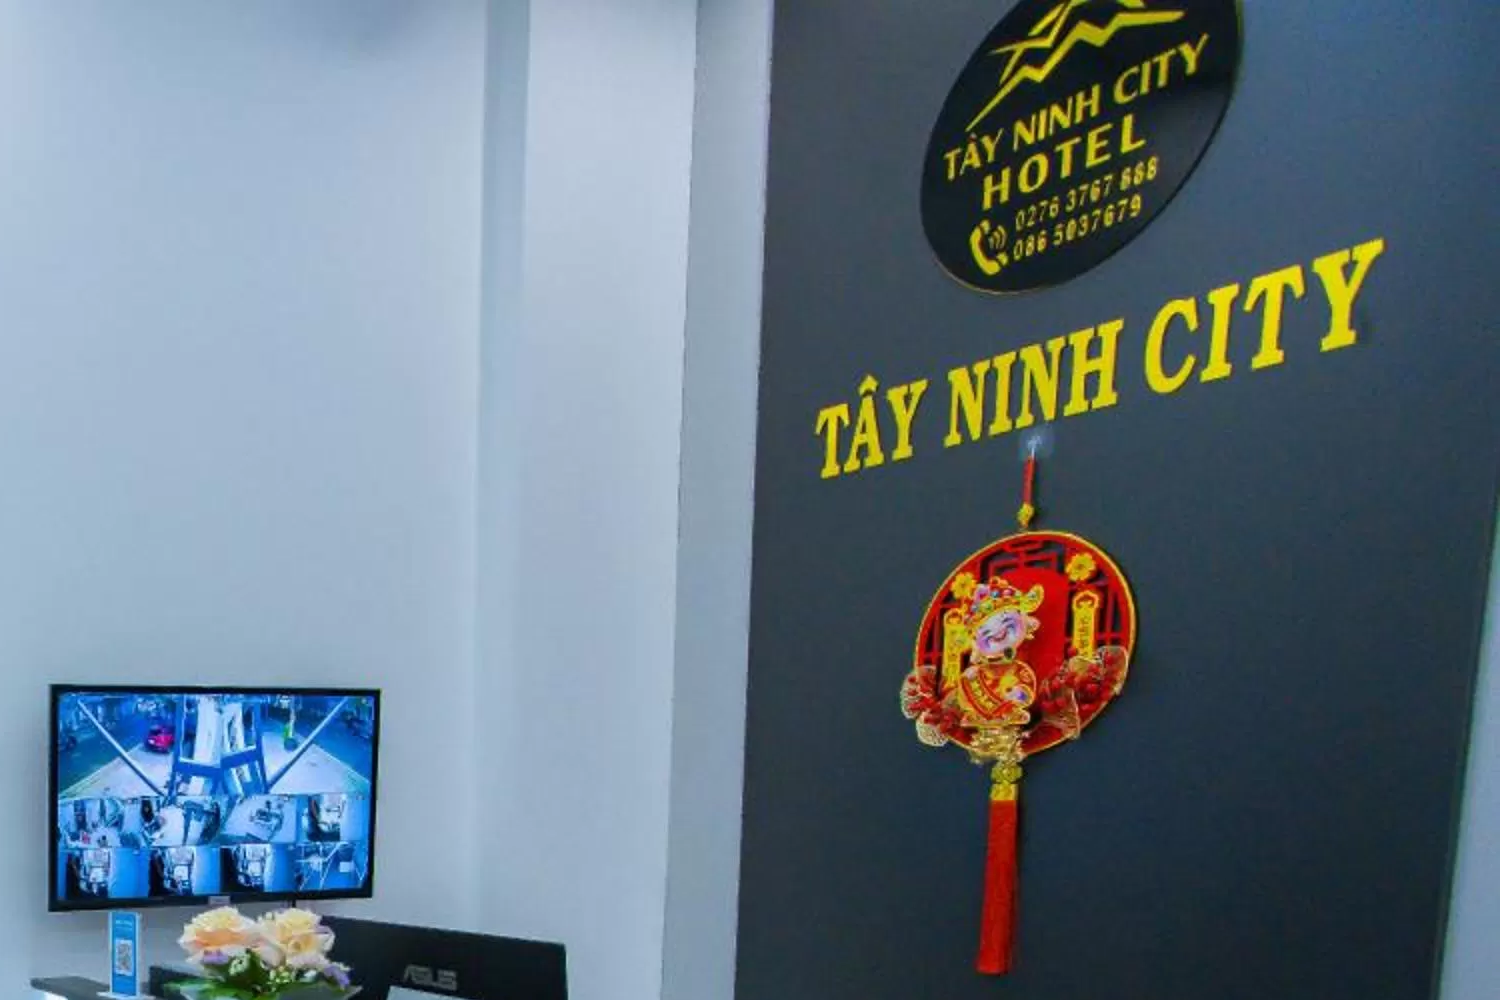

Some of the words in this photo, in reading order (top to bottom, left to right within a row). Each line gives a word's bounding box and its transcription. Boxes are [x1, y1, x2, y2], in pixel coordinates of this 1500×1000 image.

[1013, 84, 1100, 151] NINH
[1113, 32, 1210, 105] CITY
[982, 113, 1147, 211] HOTEL
[1015, 196, 1060, 231] 0276
[1065, 174, 1114, 212] 3767
[1053, 194, 1143, 247] 5037679
[814, 375, 929, 479] TÂY
[944, 319, 1125, 449] NINH
[1144, 238, 1386, 393] CITY
